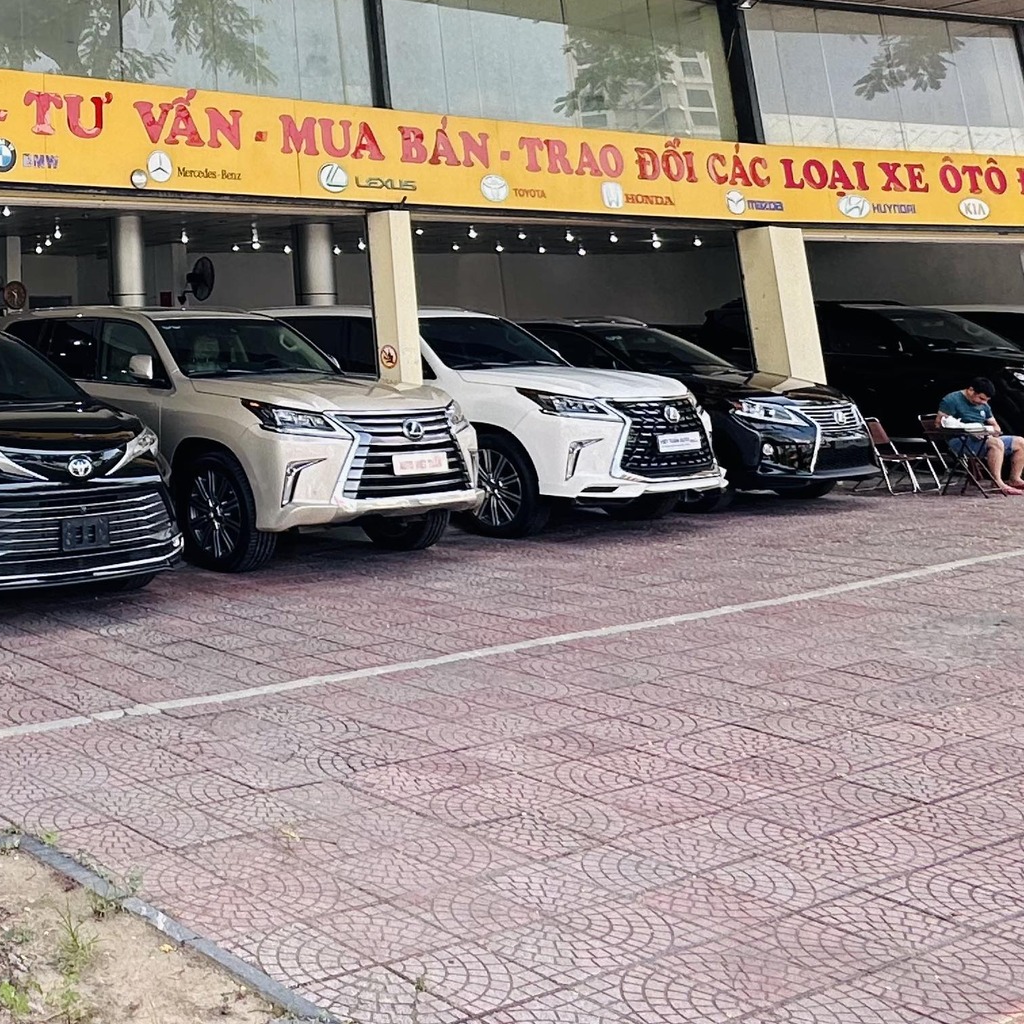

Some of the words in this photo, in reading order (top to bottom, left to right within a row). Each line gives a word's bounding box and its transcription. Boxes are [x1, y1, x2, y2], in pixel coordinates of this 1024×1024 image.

[24, 89, 113, 140] TƯ
[132, 88, 243, 150] VẤN
[278, 114, 386, 161] MUA
[397, 114, 491, 169] BÁN
[518, 136, 625, 180] TRAO
[634, 137, 699, 183] ĐỔI
[706, 143, 771, 188] CÁC
[779, 158, 870, 197] LOẠI
[877, 162, 929, 193] XE
[939, 156, 1008, 195] ÔTÔ
[22, 153, 58, 169] BMW
[354, 175, 417, 191] LEXUS
[513, 187, 547, 199] TOYOTA
[624, 192, 675, 206] HONDA
